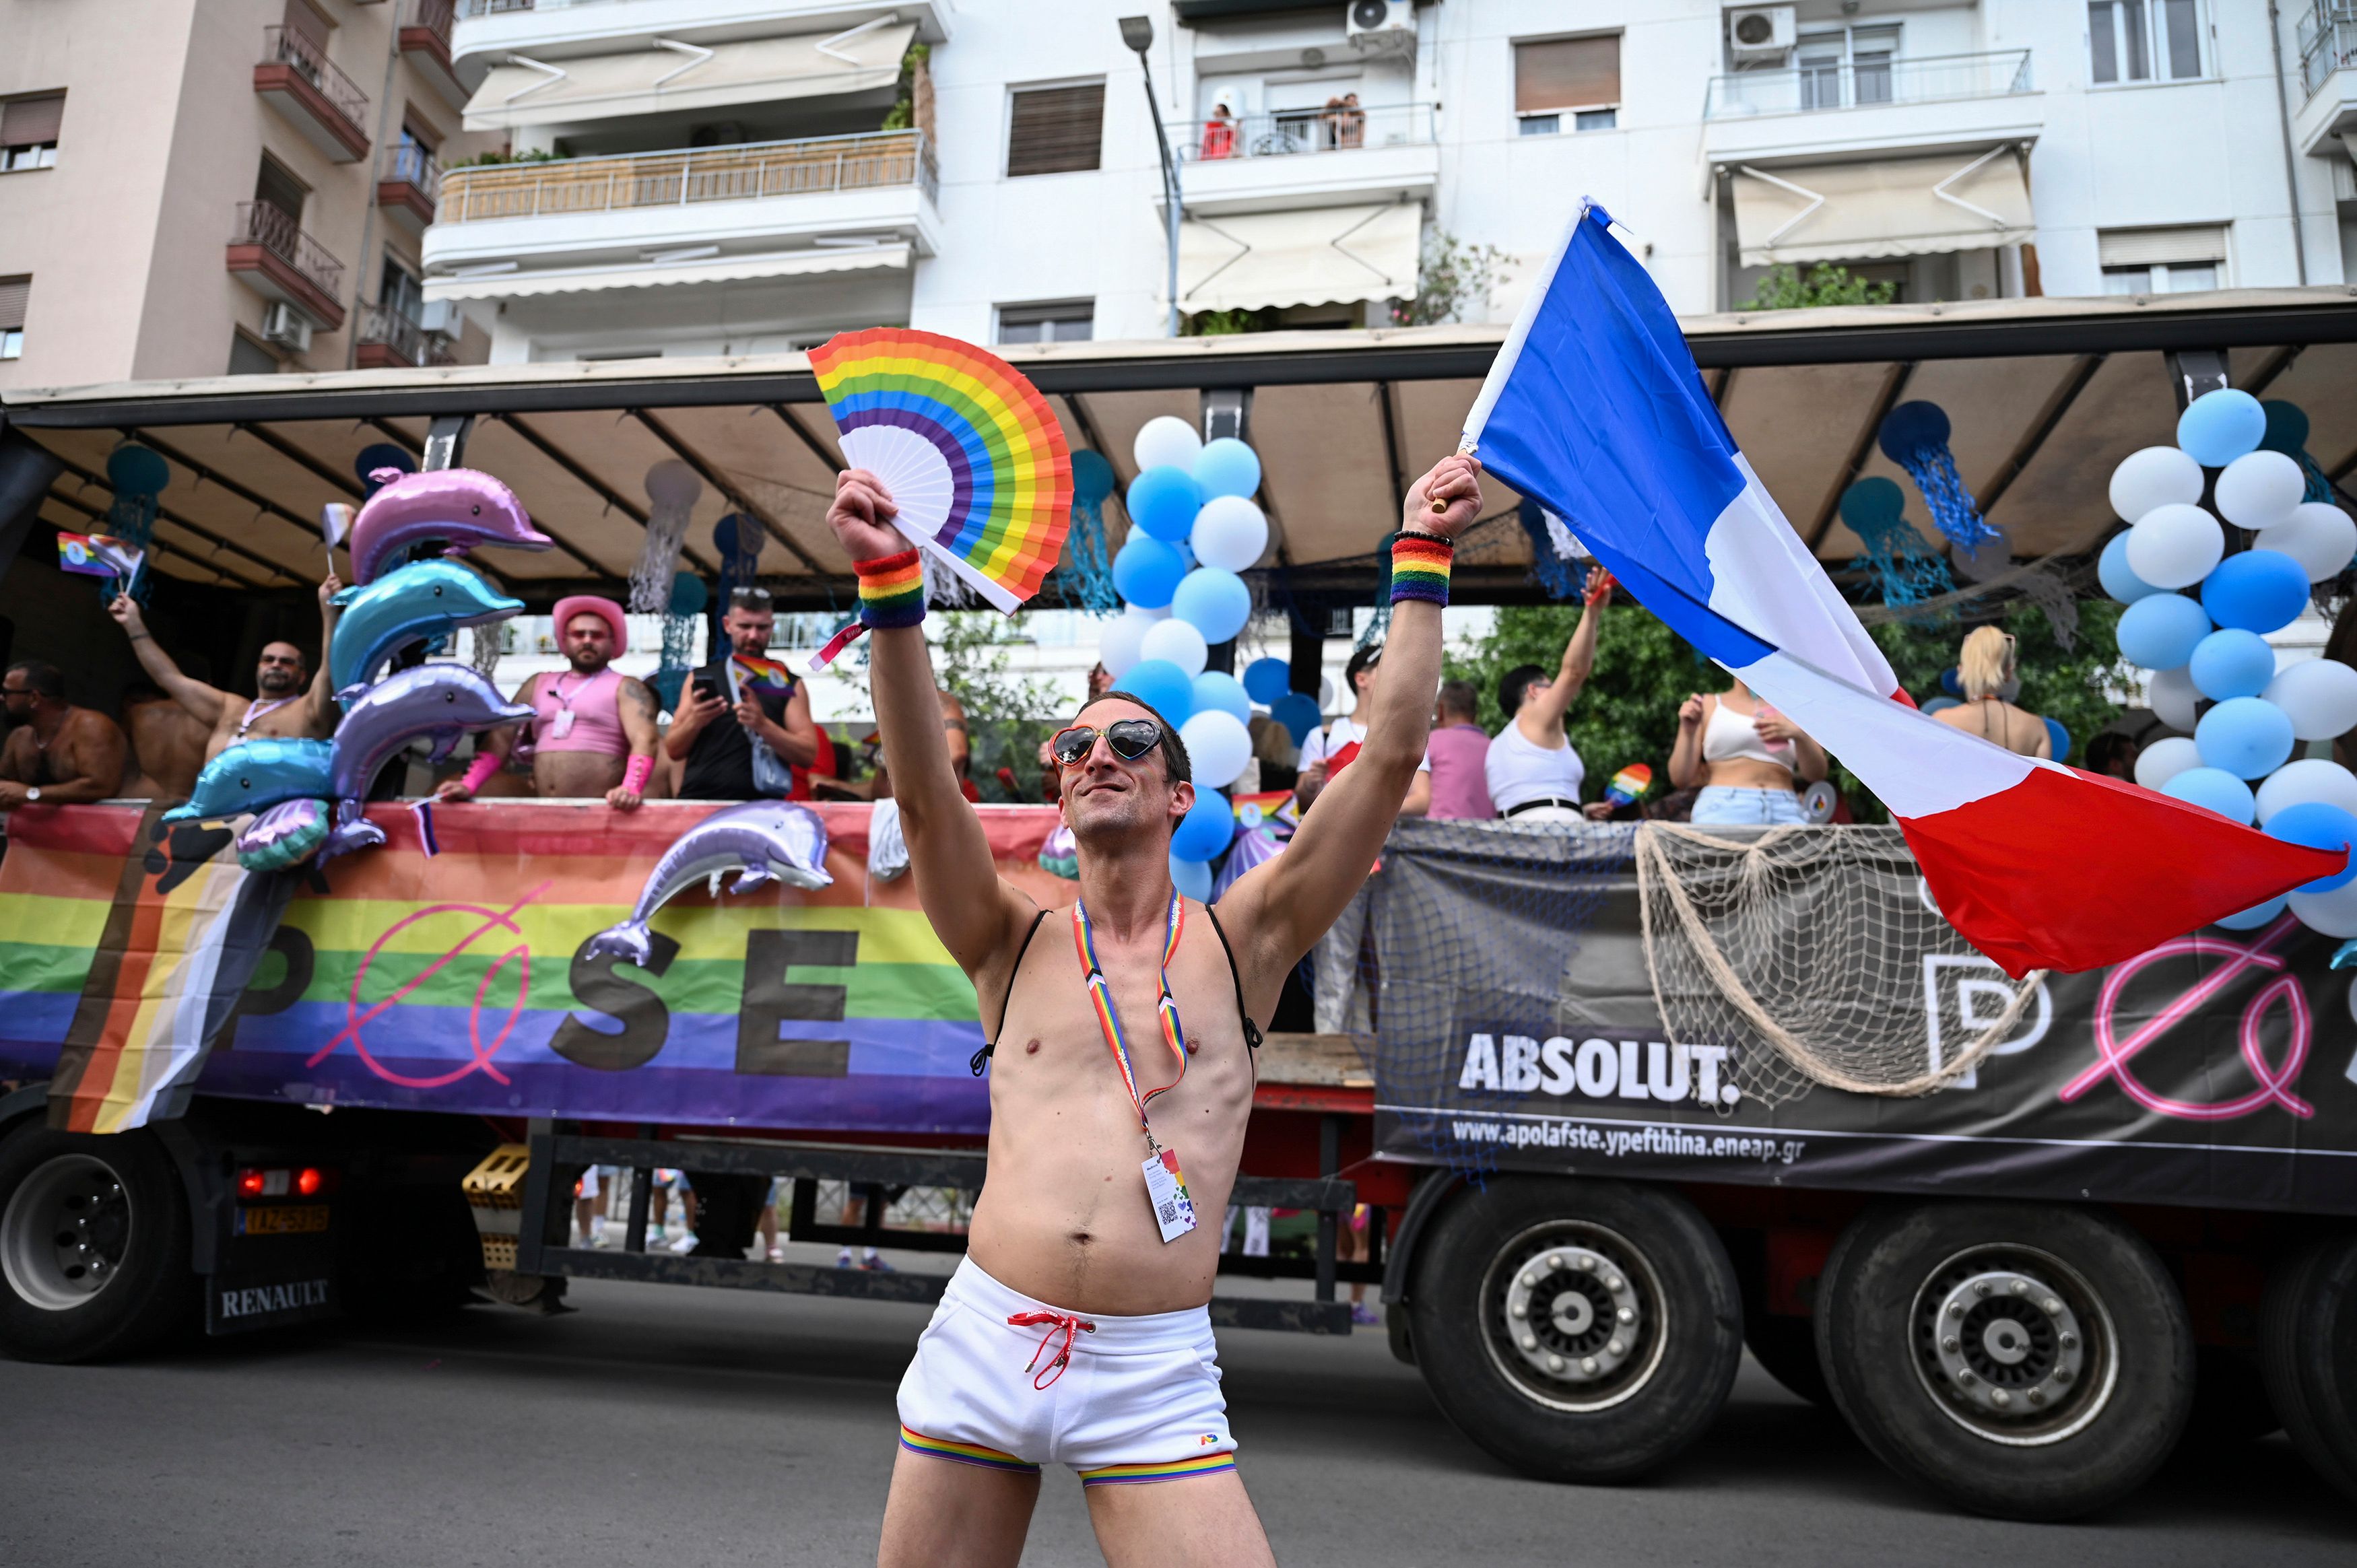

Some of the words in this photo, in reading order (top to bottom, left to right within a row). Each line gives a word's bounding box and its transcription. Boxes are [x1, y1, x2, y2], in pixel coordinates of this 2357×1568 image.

[1453, 1120, 1806, 1164] www.apolafste.ypefthina.eneap.gr
[222, 1279, 328, 1318] RENAULT
[1026, 1309, 1059, 1318] ADDICTED
[1066, 1320, 1077, 1356] ADDICTED
